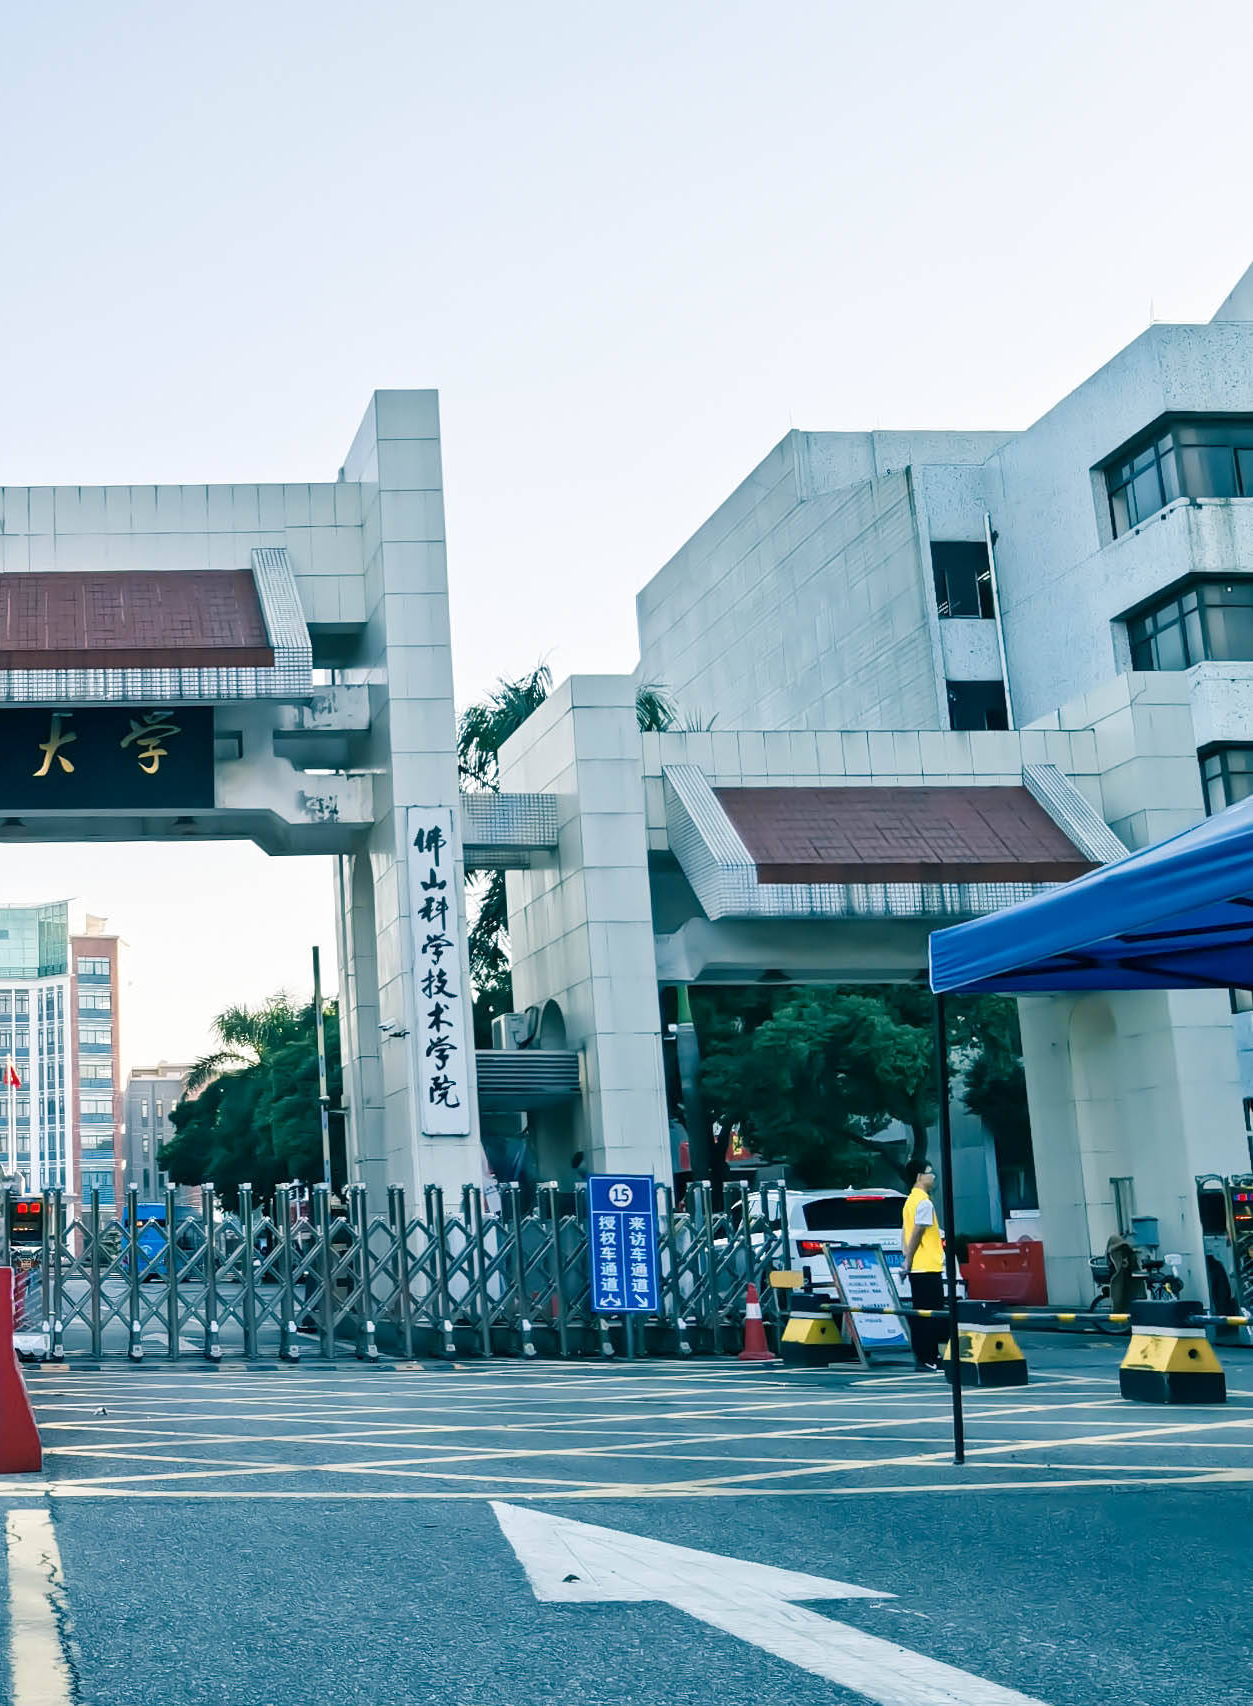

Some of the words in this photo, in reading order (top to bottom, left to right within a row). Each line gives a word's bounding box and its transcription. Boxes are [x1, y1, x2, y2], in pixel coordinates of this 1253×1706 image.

[413, 825, 460, 1108] 佛山科学技术学院
[613, 1188, 630, 1202] 15
[598, 1215, 619, 1292] 授权车通道
[628, 1216, 649, 1293] 来访车通道
